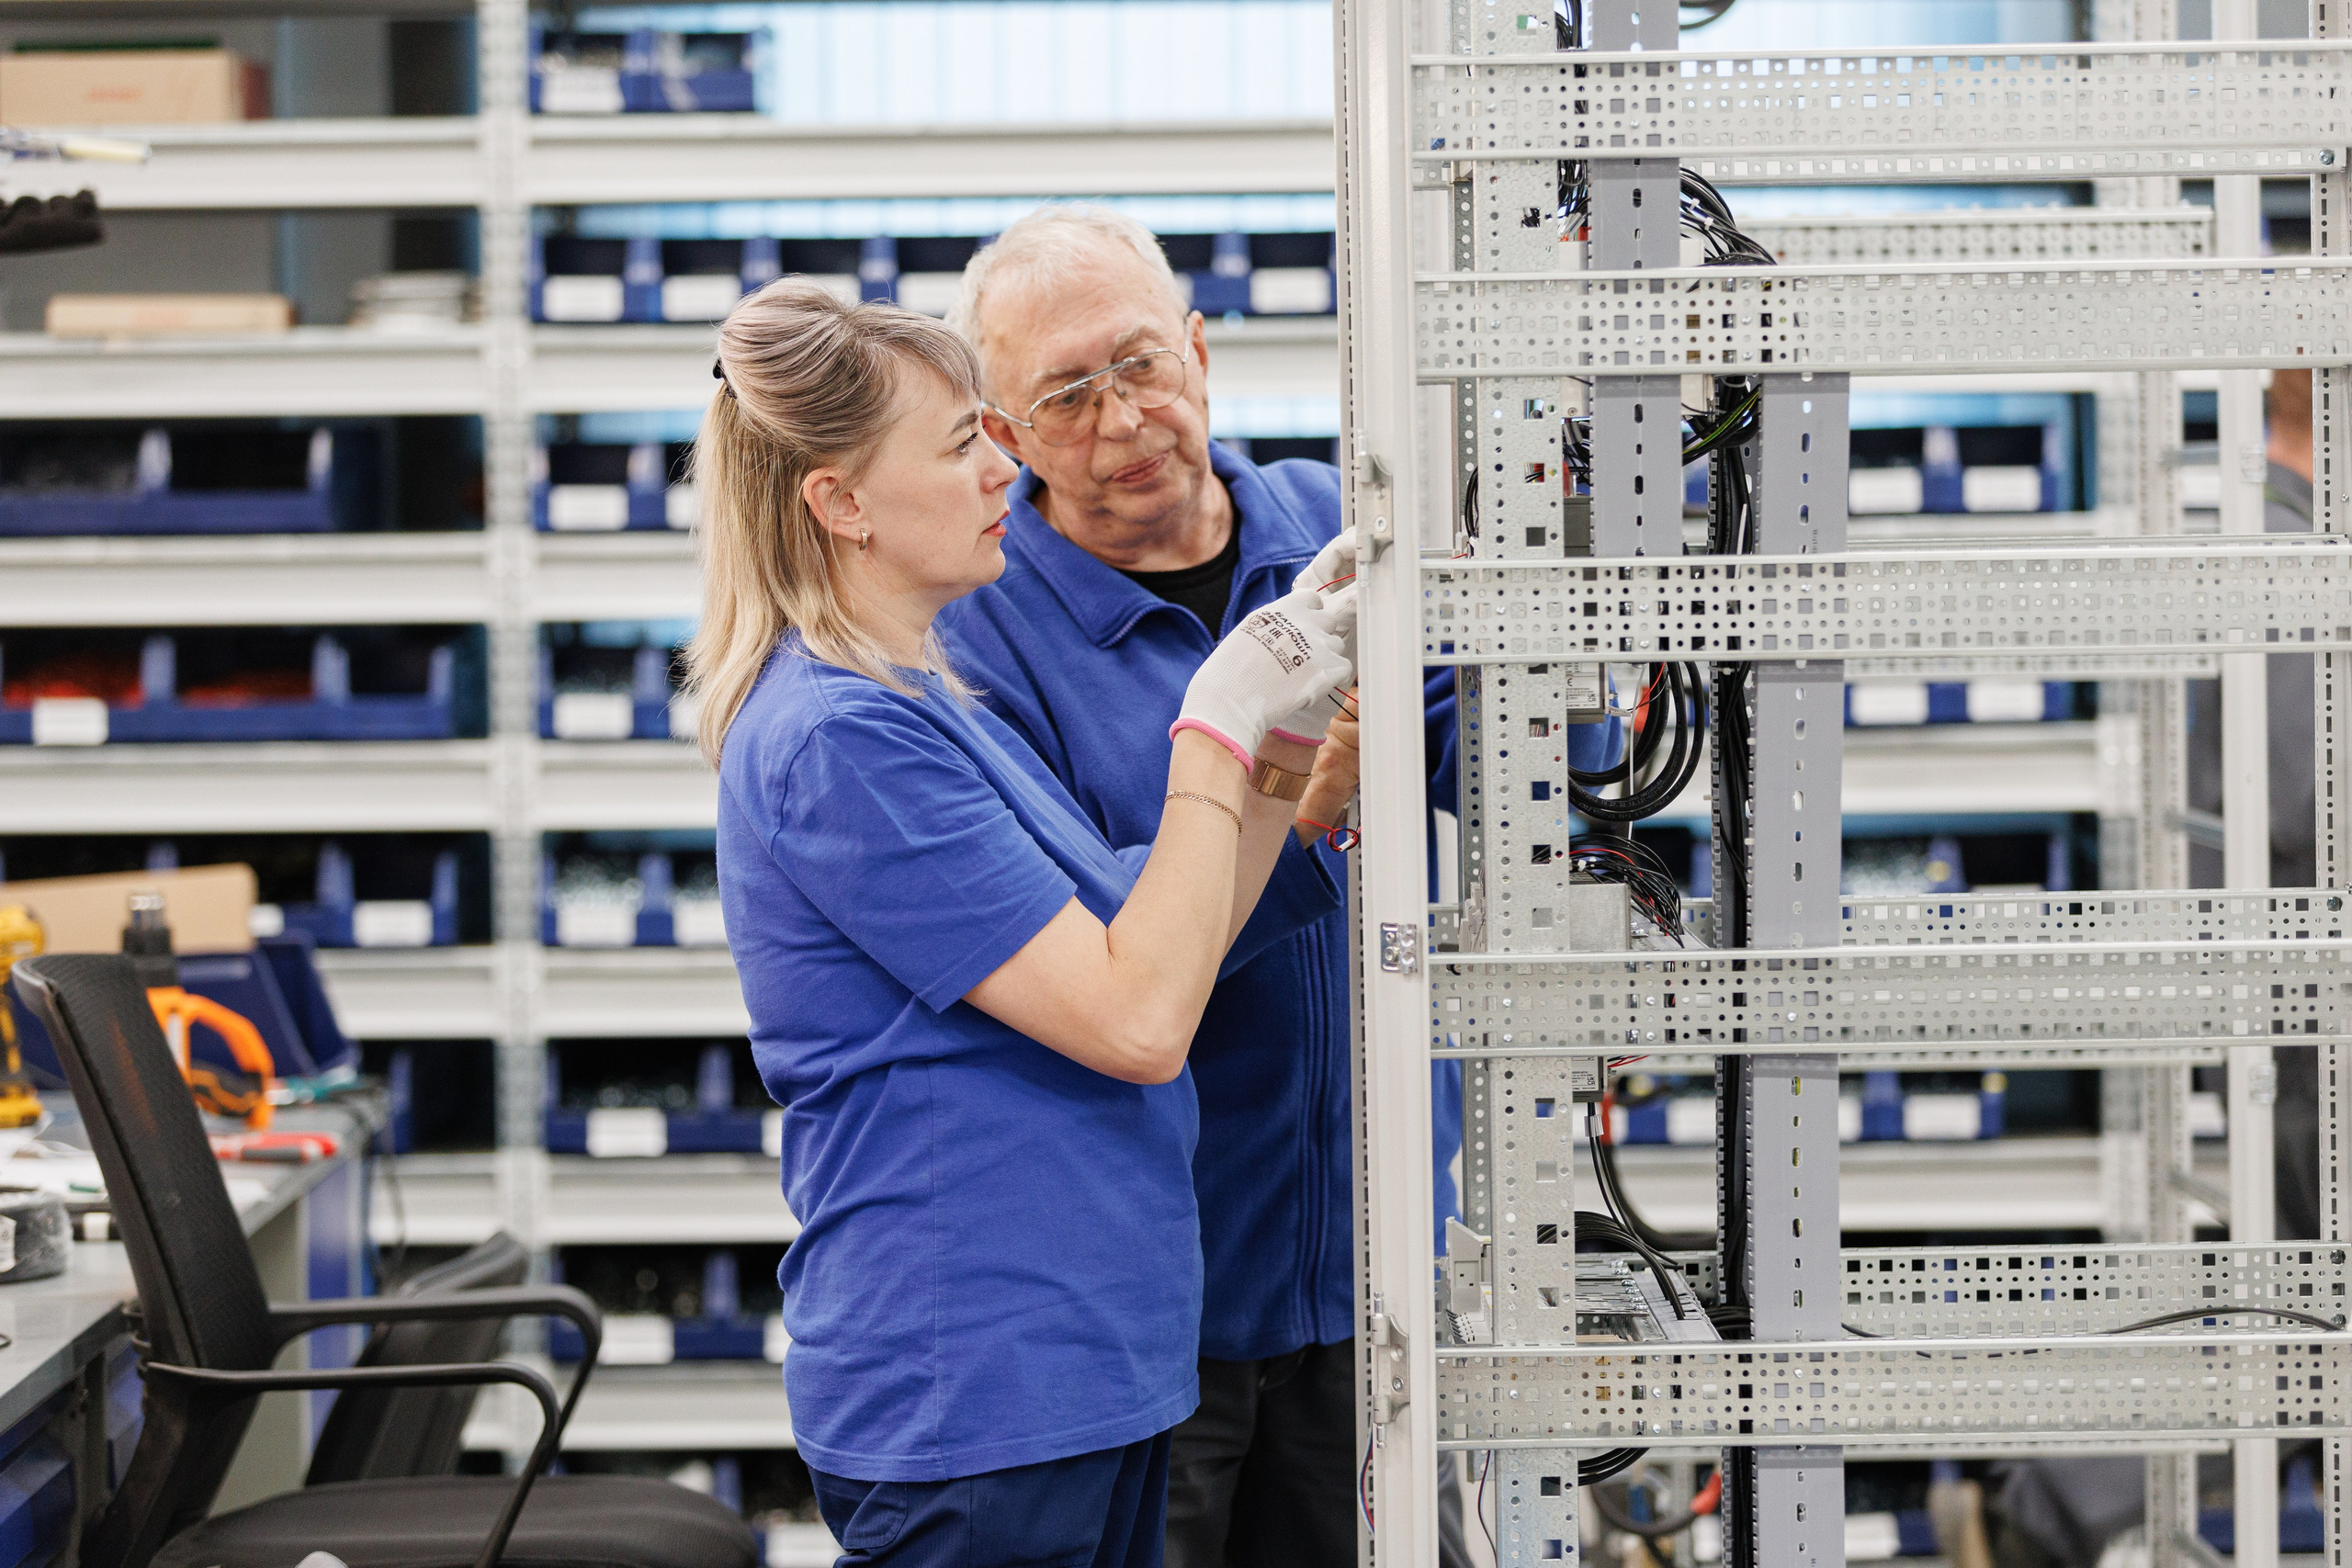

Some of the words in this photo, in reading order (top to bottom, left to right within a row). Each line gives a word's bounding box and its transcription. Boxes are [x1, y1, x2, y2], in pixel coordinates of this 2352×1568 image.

[1261, 611, 1311, 660] ЭВОЛЮШН
[1274, 612, 1313, 651] БАНТИНГ
[1292, 654, 1305, 667] 6
